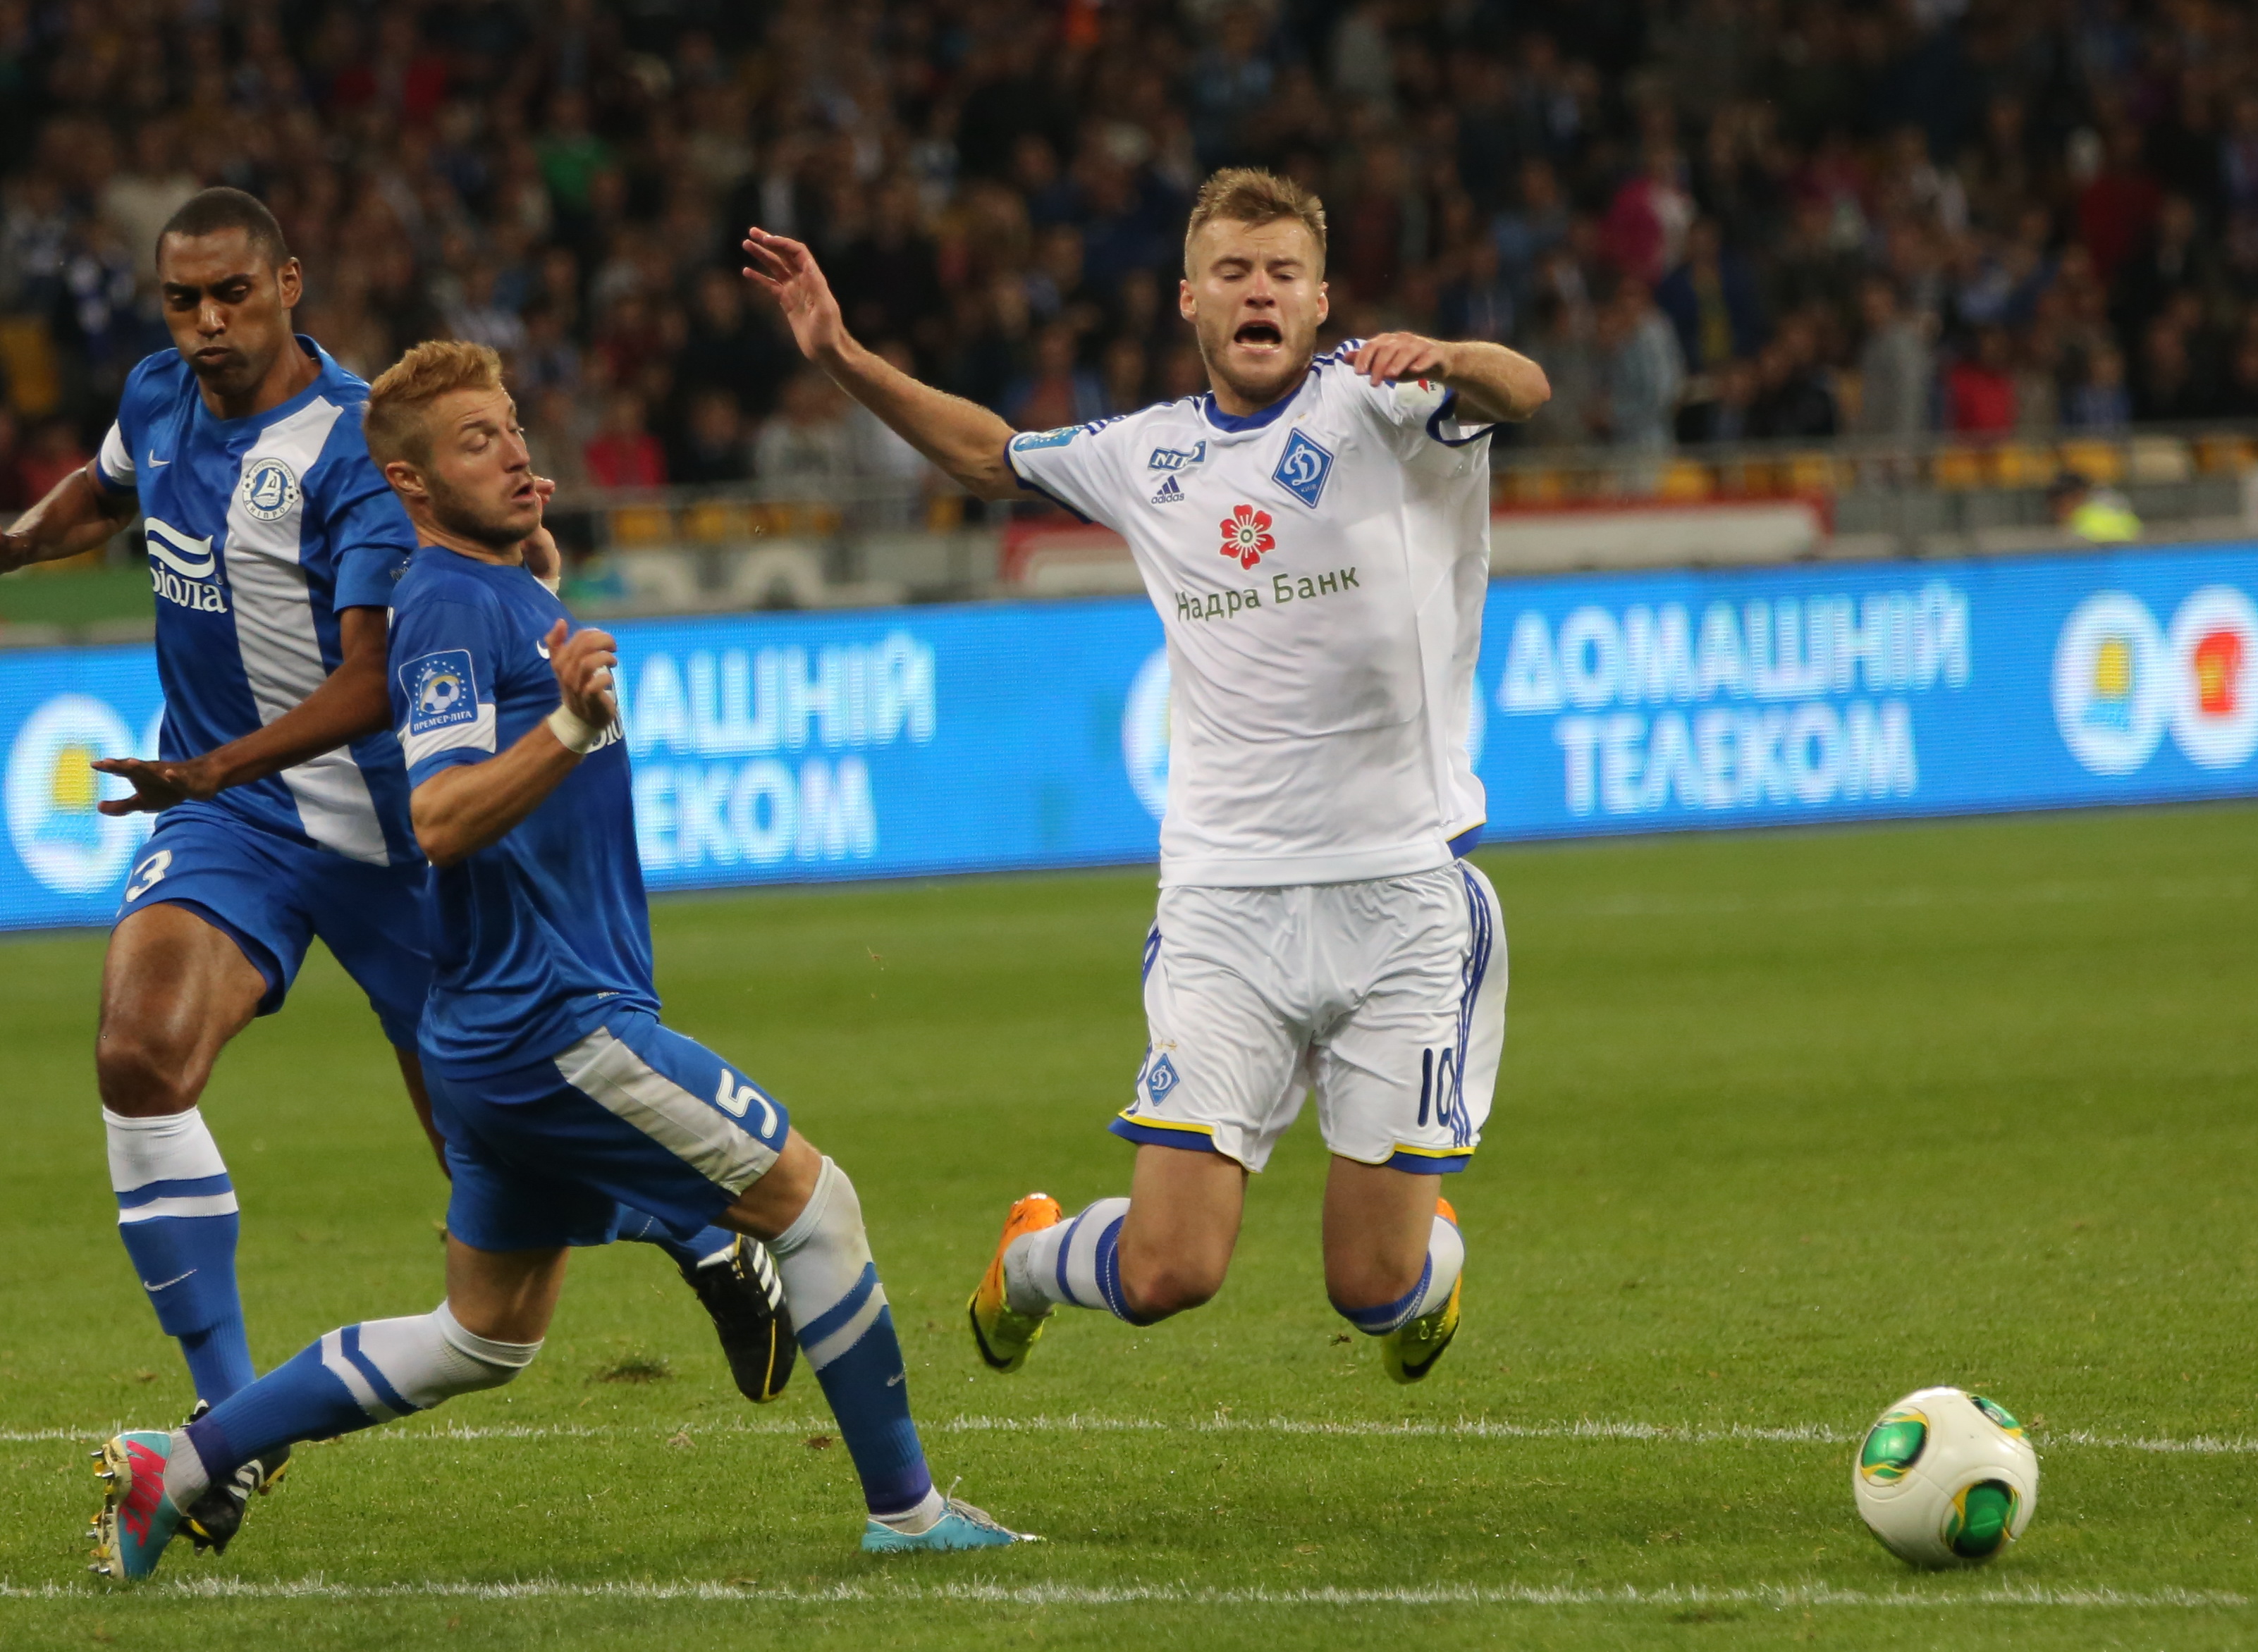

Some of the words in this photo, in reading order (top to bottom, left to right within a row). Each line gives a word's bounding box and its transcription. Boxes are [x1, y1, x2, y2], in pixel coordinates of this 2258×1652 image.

[244, 500, 286, 519] ДНІПРО
[1151, 493, 1185, 504] adidas
[1175, 588, 1261, 623] Надра
[1272, 566, 1360, 604] Банк
[1497, 579, 1972, 715] ДОМАШНІЙ
[1553, 699, 1919, 818] ТЕЛЕКОМ
[715, 1067, 778, 1140] 5
[1418, 1048, 1454, 1127] 10
